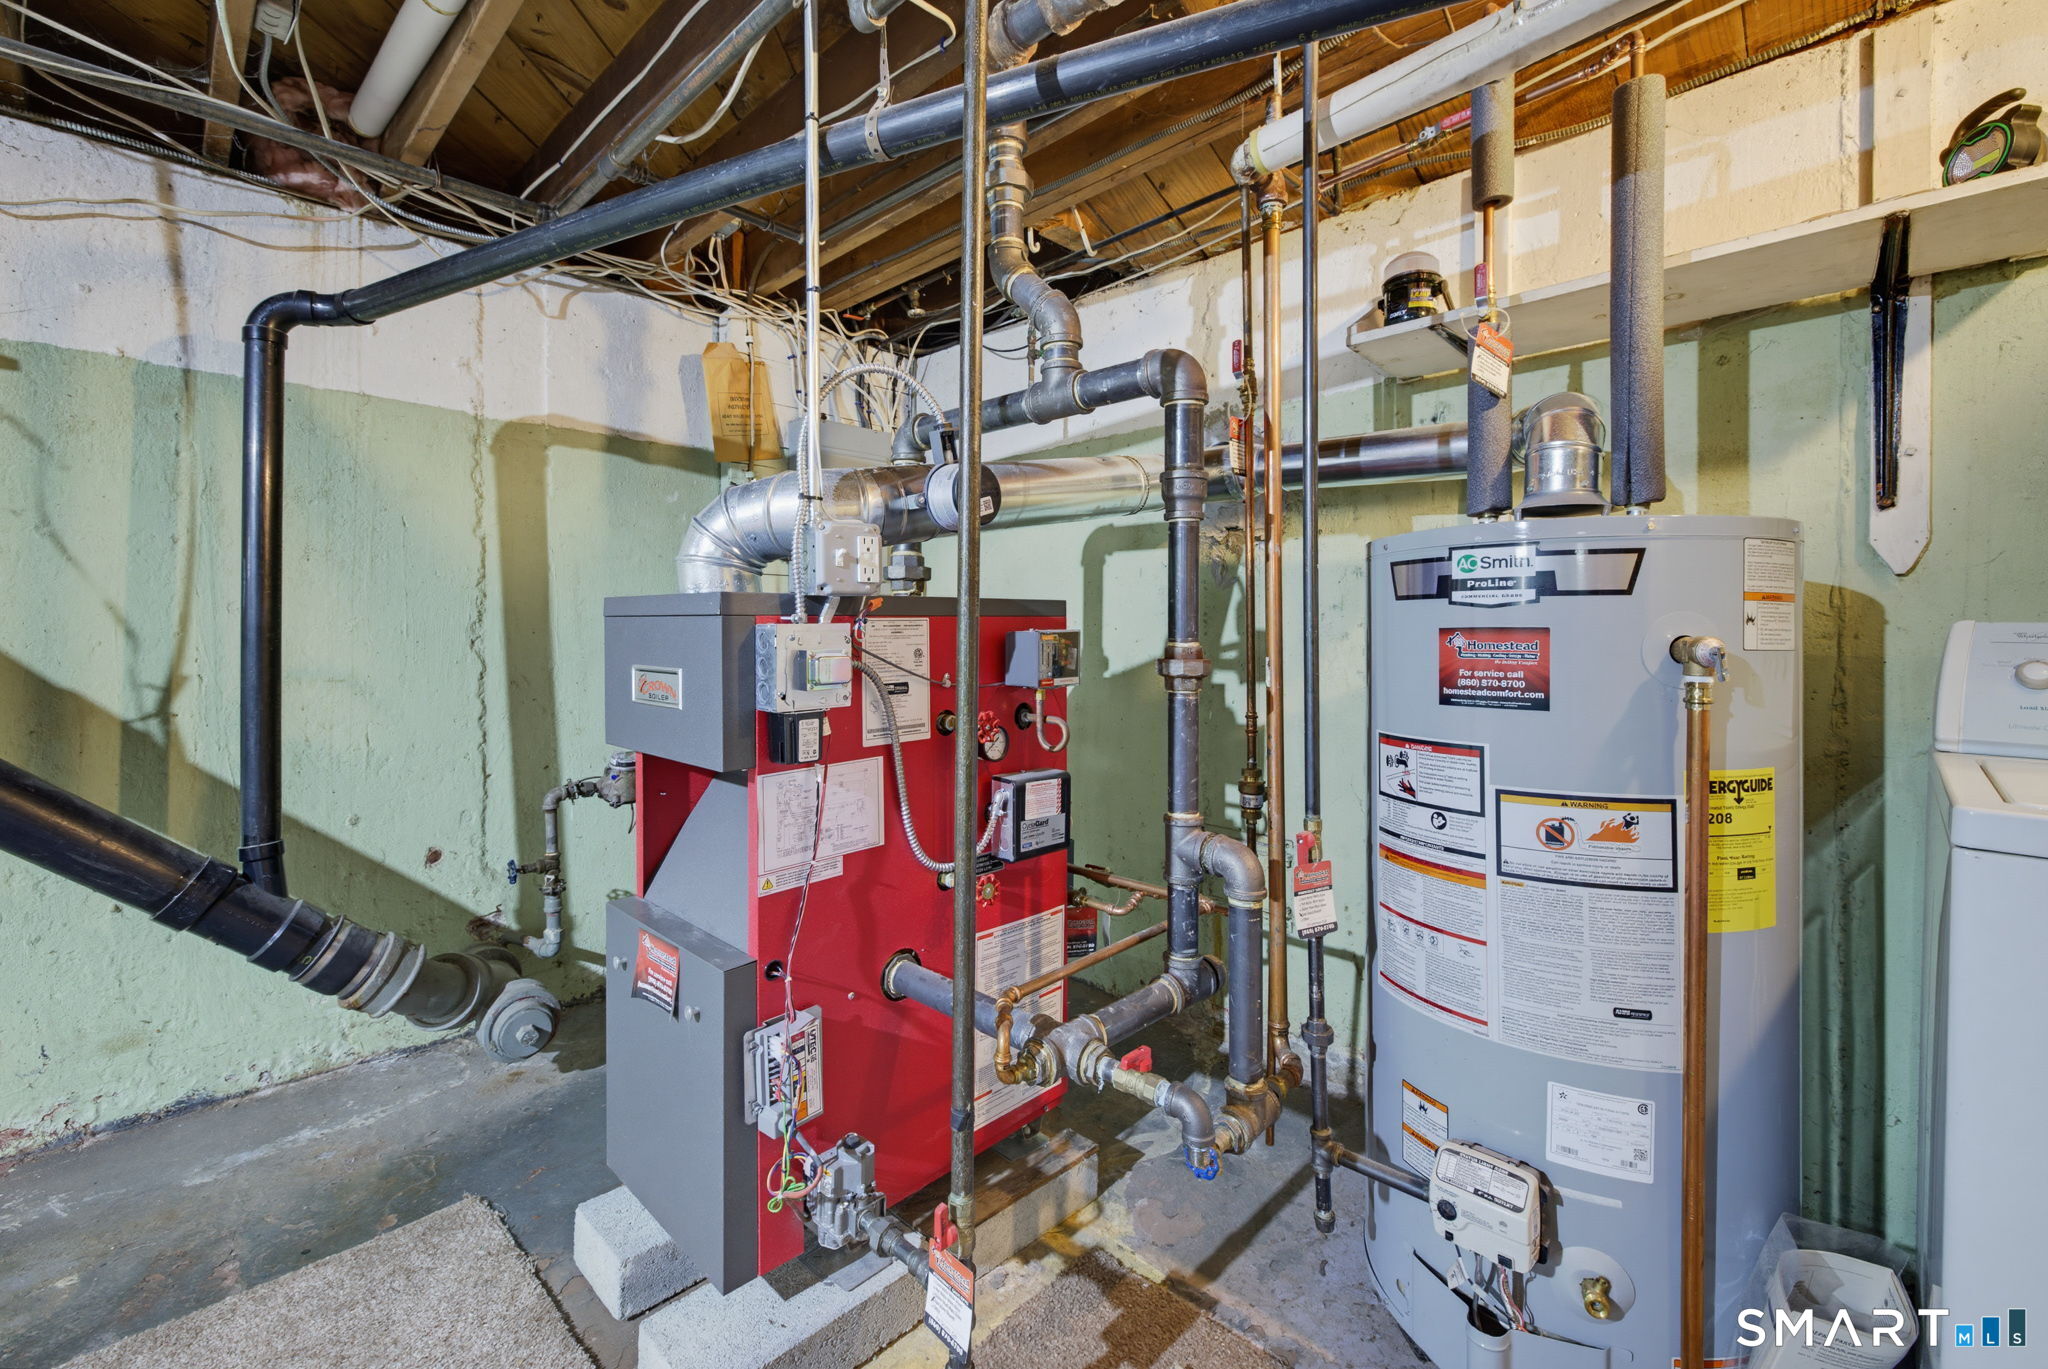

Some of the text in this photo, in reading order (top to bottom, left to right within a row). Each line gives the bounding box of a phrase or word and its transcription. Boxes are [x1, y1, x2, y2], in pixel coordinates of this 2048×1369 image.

[1466, 579, 1516, 588] ProLine
[1467, 640, 1540, 651] Homestead
[1457, 678, 1480, 687] (860)
[640, 679, 677, 700] CROWN
[1443, 687, 1545, 699] homesteadcomfort.com
[648, 692, 669, 701] BOILER
[1570, 801, 1609, 810] WARNING
